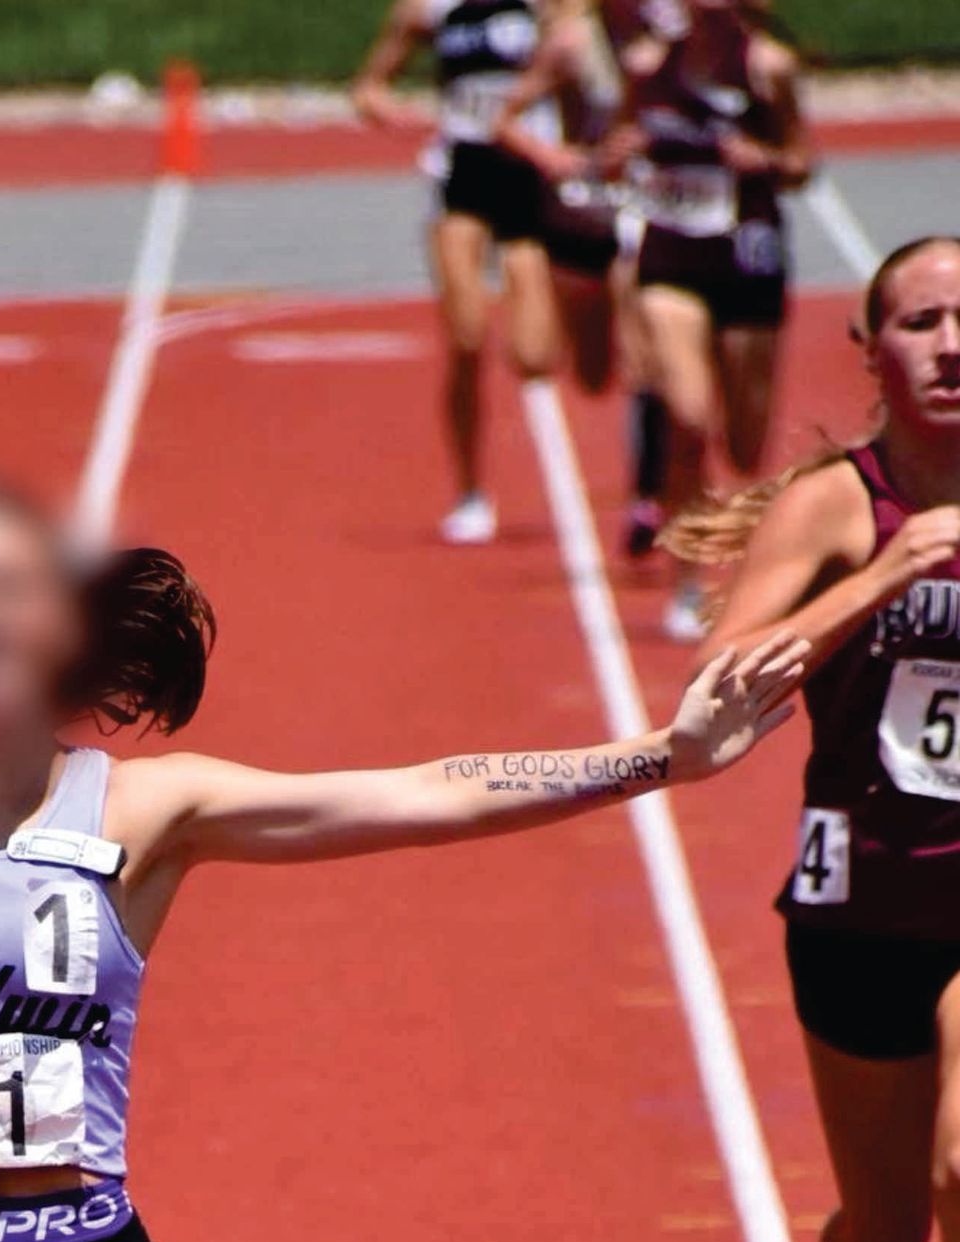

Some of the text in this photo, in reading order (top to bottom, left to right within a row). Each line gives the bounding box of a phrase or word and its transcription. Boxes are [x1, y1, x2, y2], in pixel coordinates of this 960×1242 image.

[444, 754, 669, 781] FOR GODS GLORY
[801, 821, 830, 891] 4
[34, 893, 69, 983] 1
